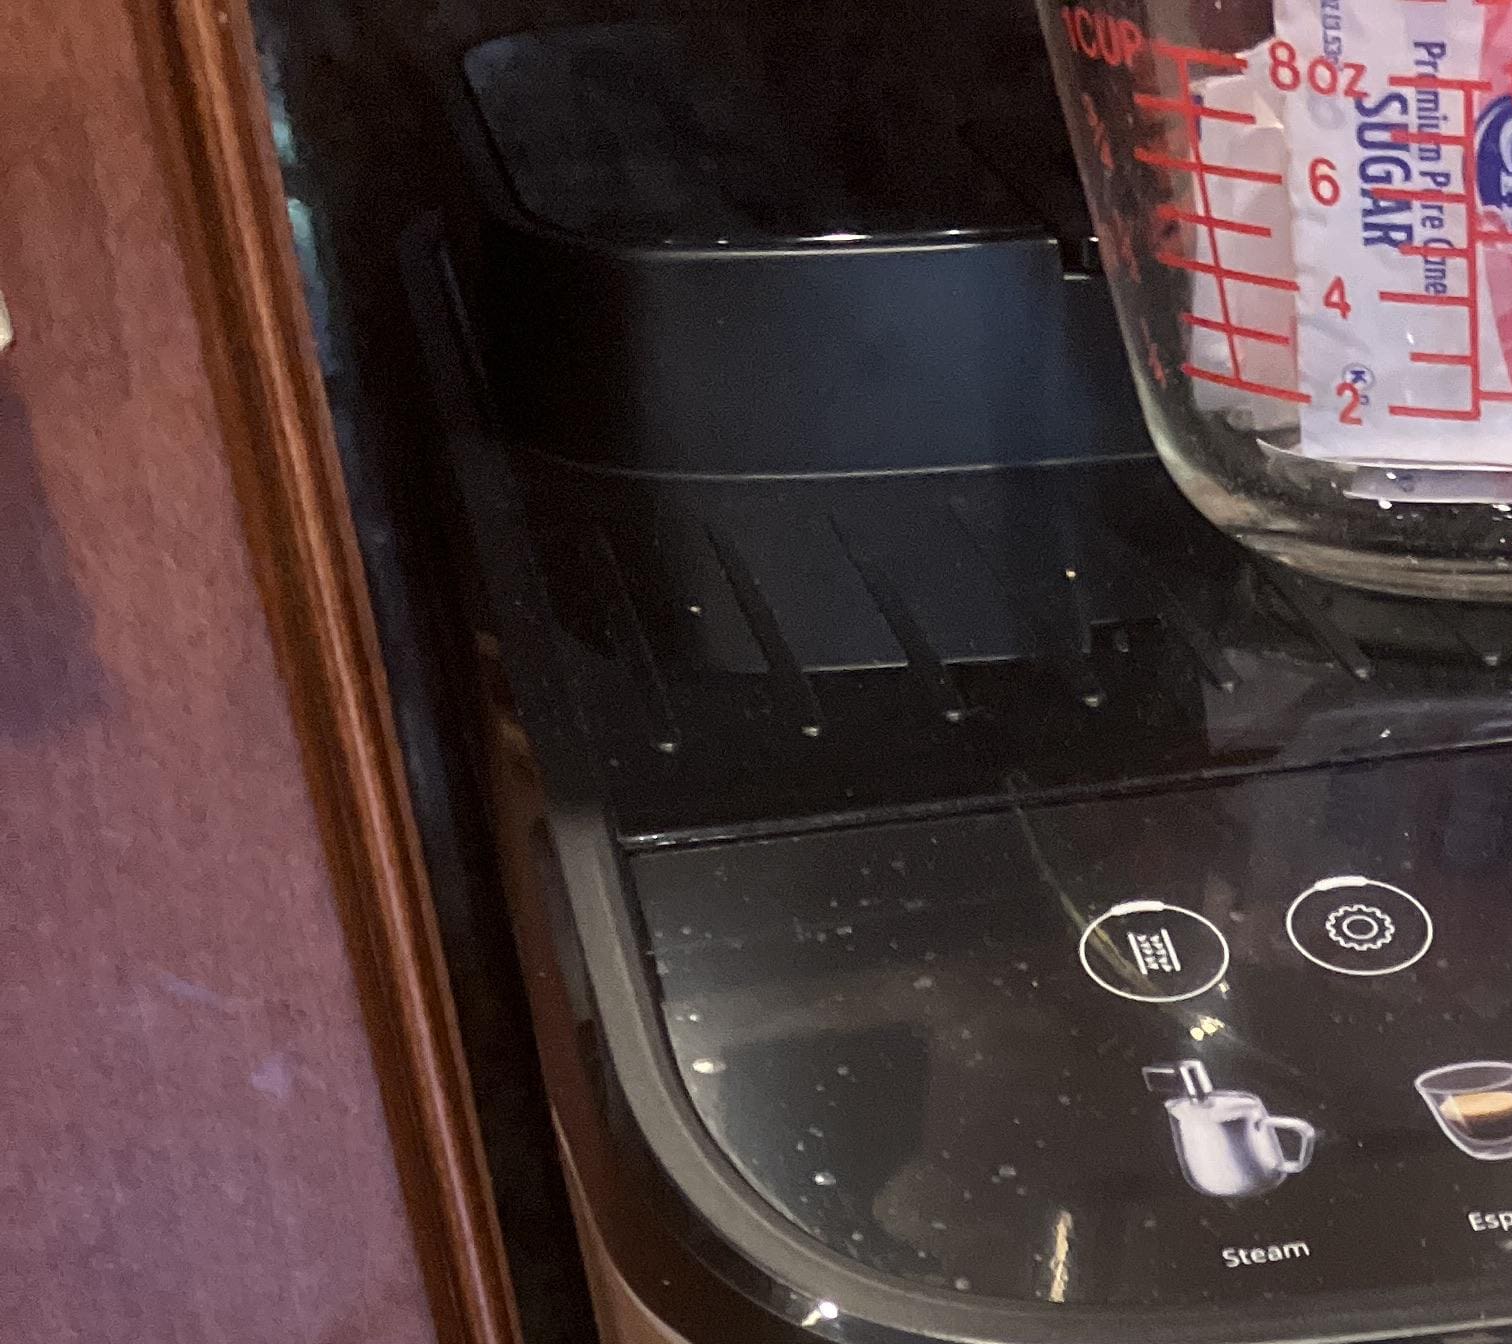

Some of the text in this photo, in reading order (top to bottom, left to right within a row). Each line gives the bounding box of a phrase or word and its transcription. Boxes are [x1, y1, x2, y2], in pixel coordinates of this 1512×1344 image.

[1308, 157, 1340, 204] 6
[1353, 91, 1414, 248] SUGAR
[1413, 40, 1455, 295] Prmium Pre Cne
[1323, 276, 1351, 319] 4
[1335, 381, 1363, 426] 2
[1221, 1238, 1311, 1268] Steam
